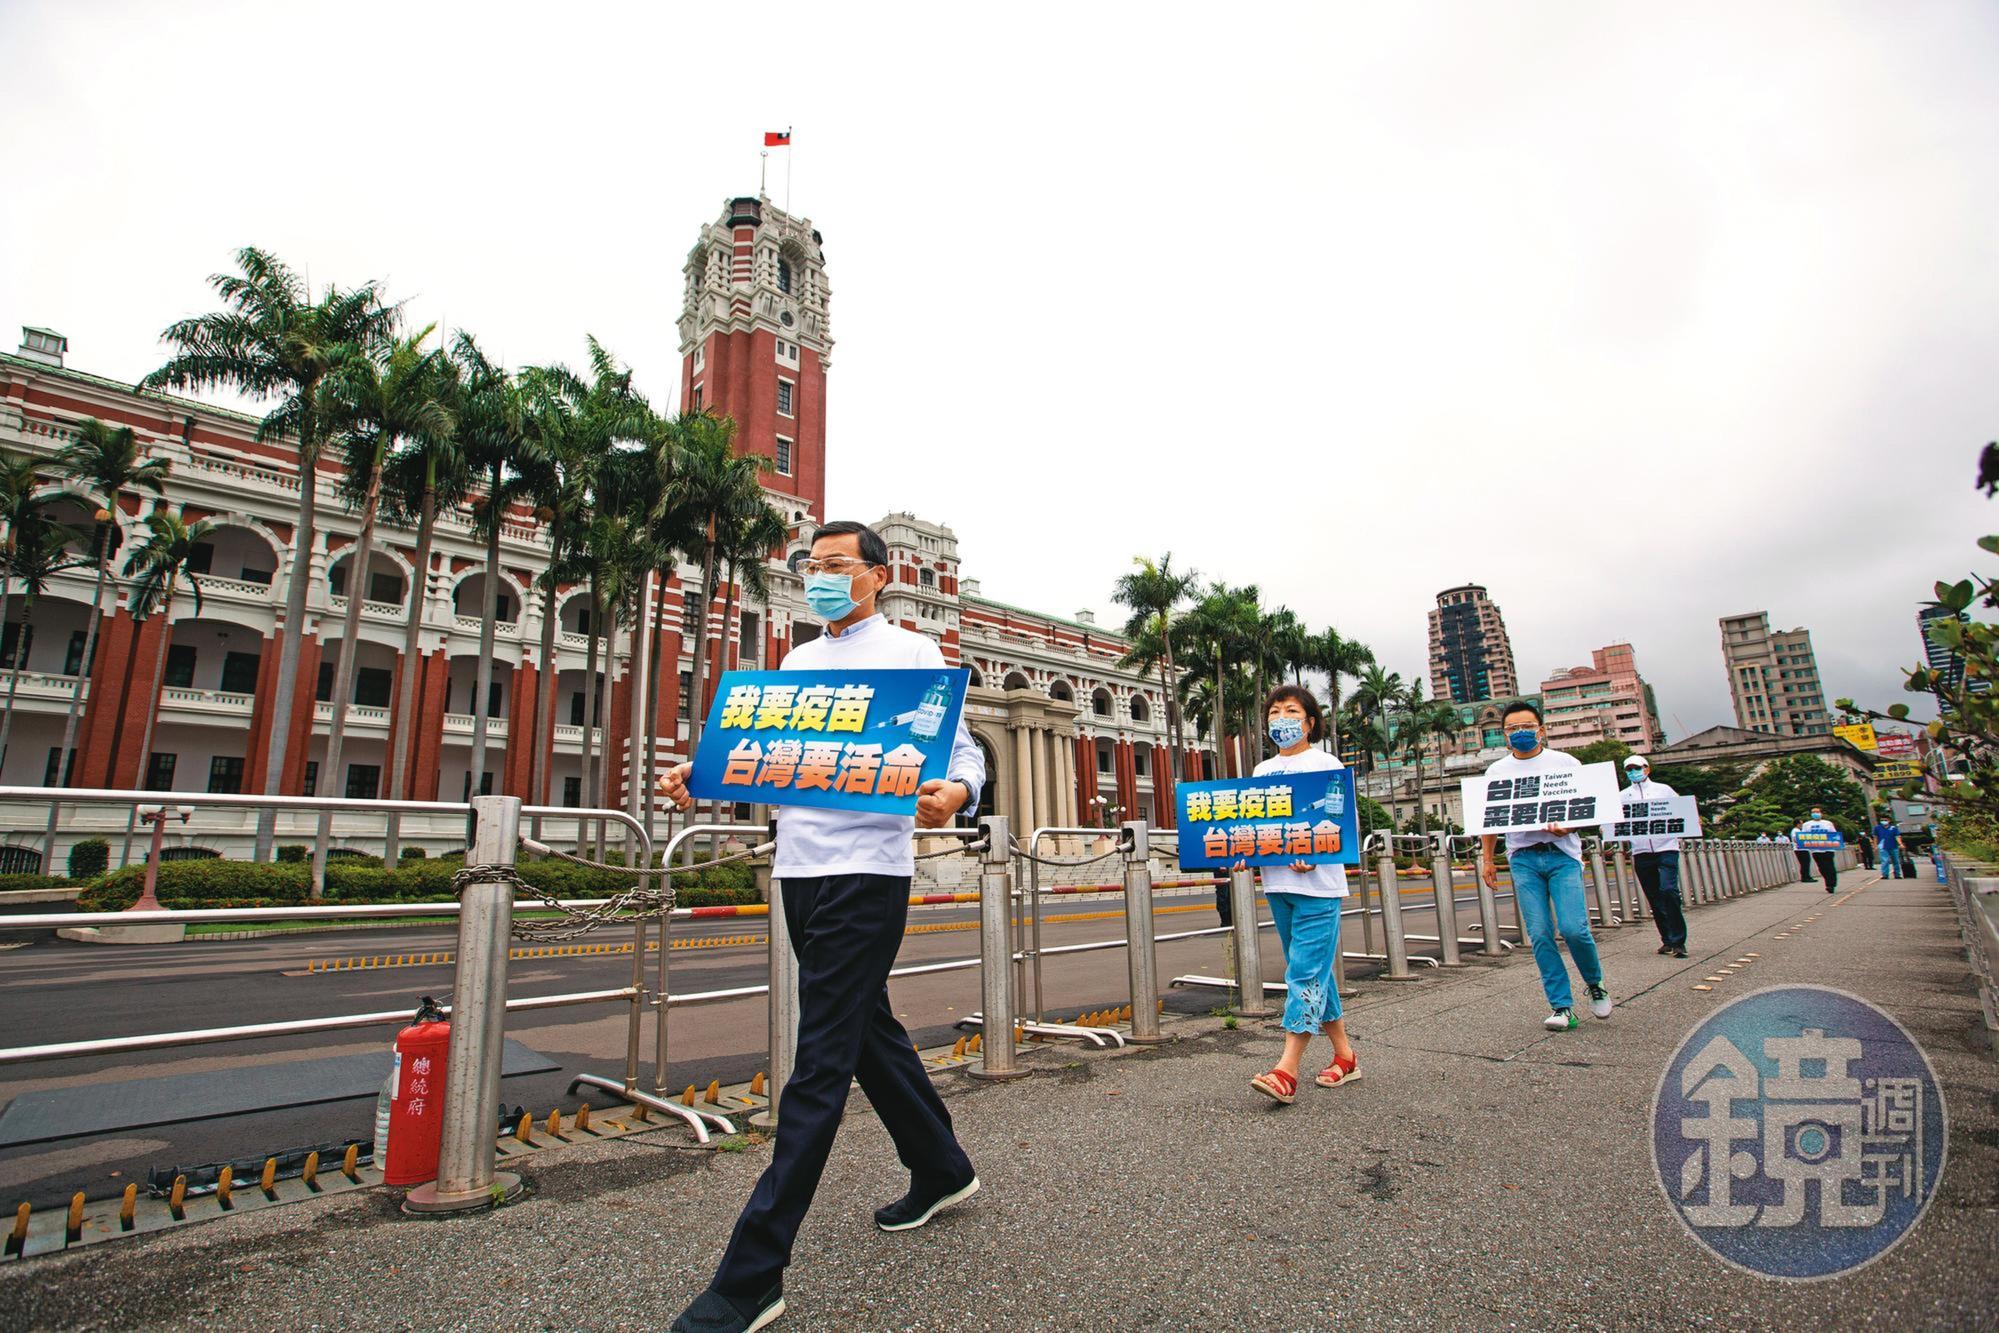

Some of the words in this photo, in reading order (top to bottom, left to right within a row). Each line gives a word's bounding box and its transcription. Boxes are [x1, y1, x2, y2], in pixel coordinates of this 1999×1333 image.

[720, 684, 875, 733] 我要疫苗
[721, 738, 927, 797] 台灣要活命
[1544, 772, 1573, 781] Taiwan
[1487, 775, 1541, 802] 台灣
[1543, 780, 1568, 789] Needs
[1543, 788, 1577, 797] Vaccines
[1186, 785, 1293, 822] 我要疫苗
[1483, 796, 1597, 828] 需要疫苗
[1203, 819, 1342, 858] 台灣要活命
[1614, 817, 1685, 837] 需要疫苗
[407, 1057, 431, 1116] 總統府
